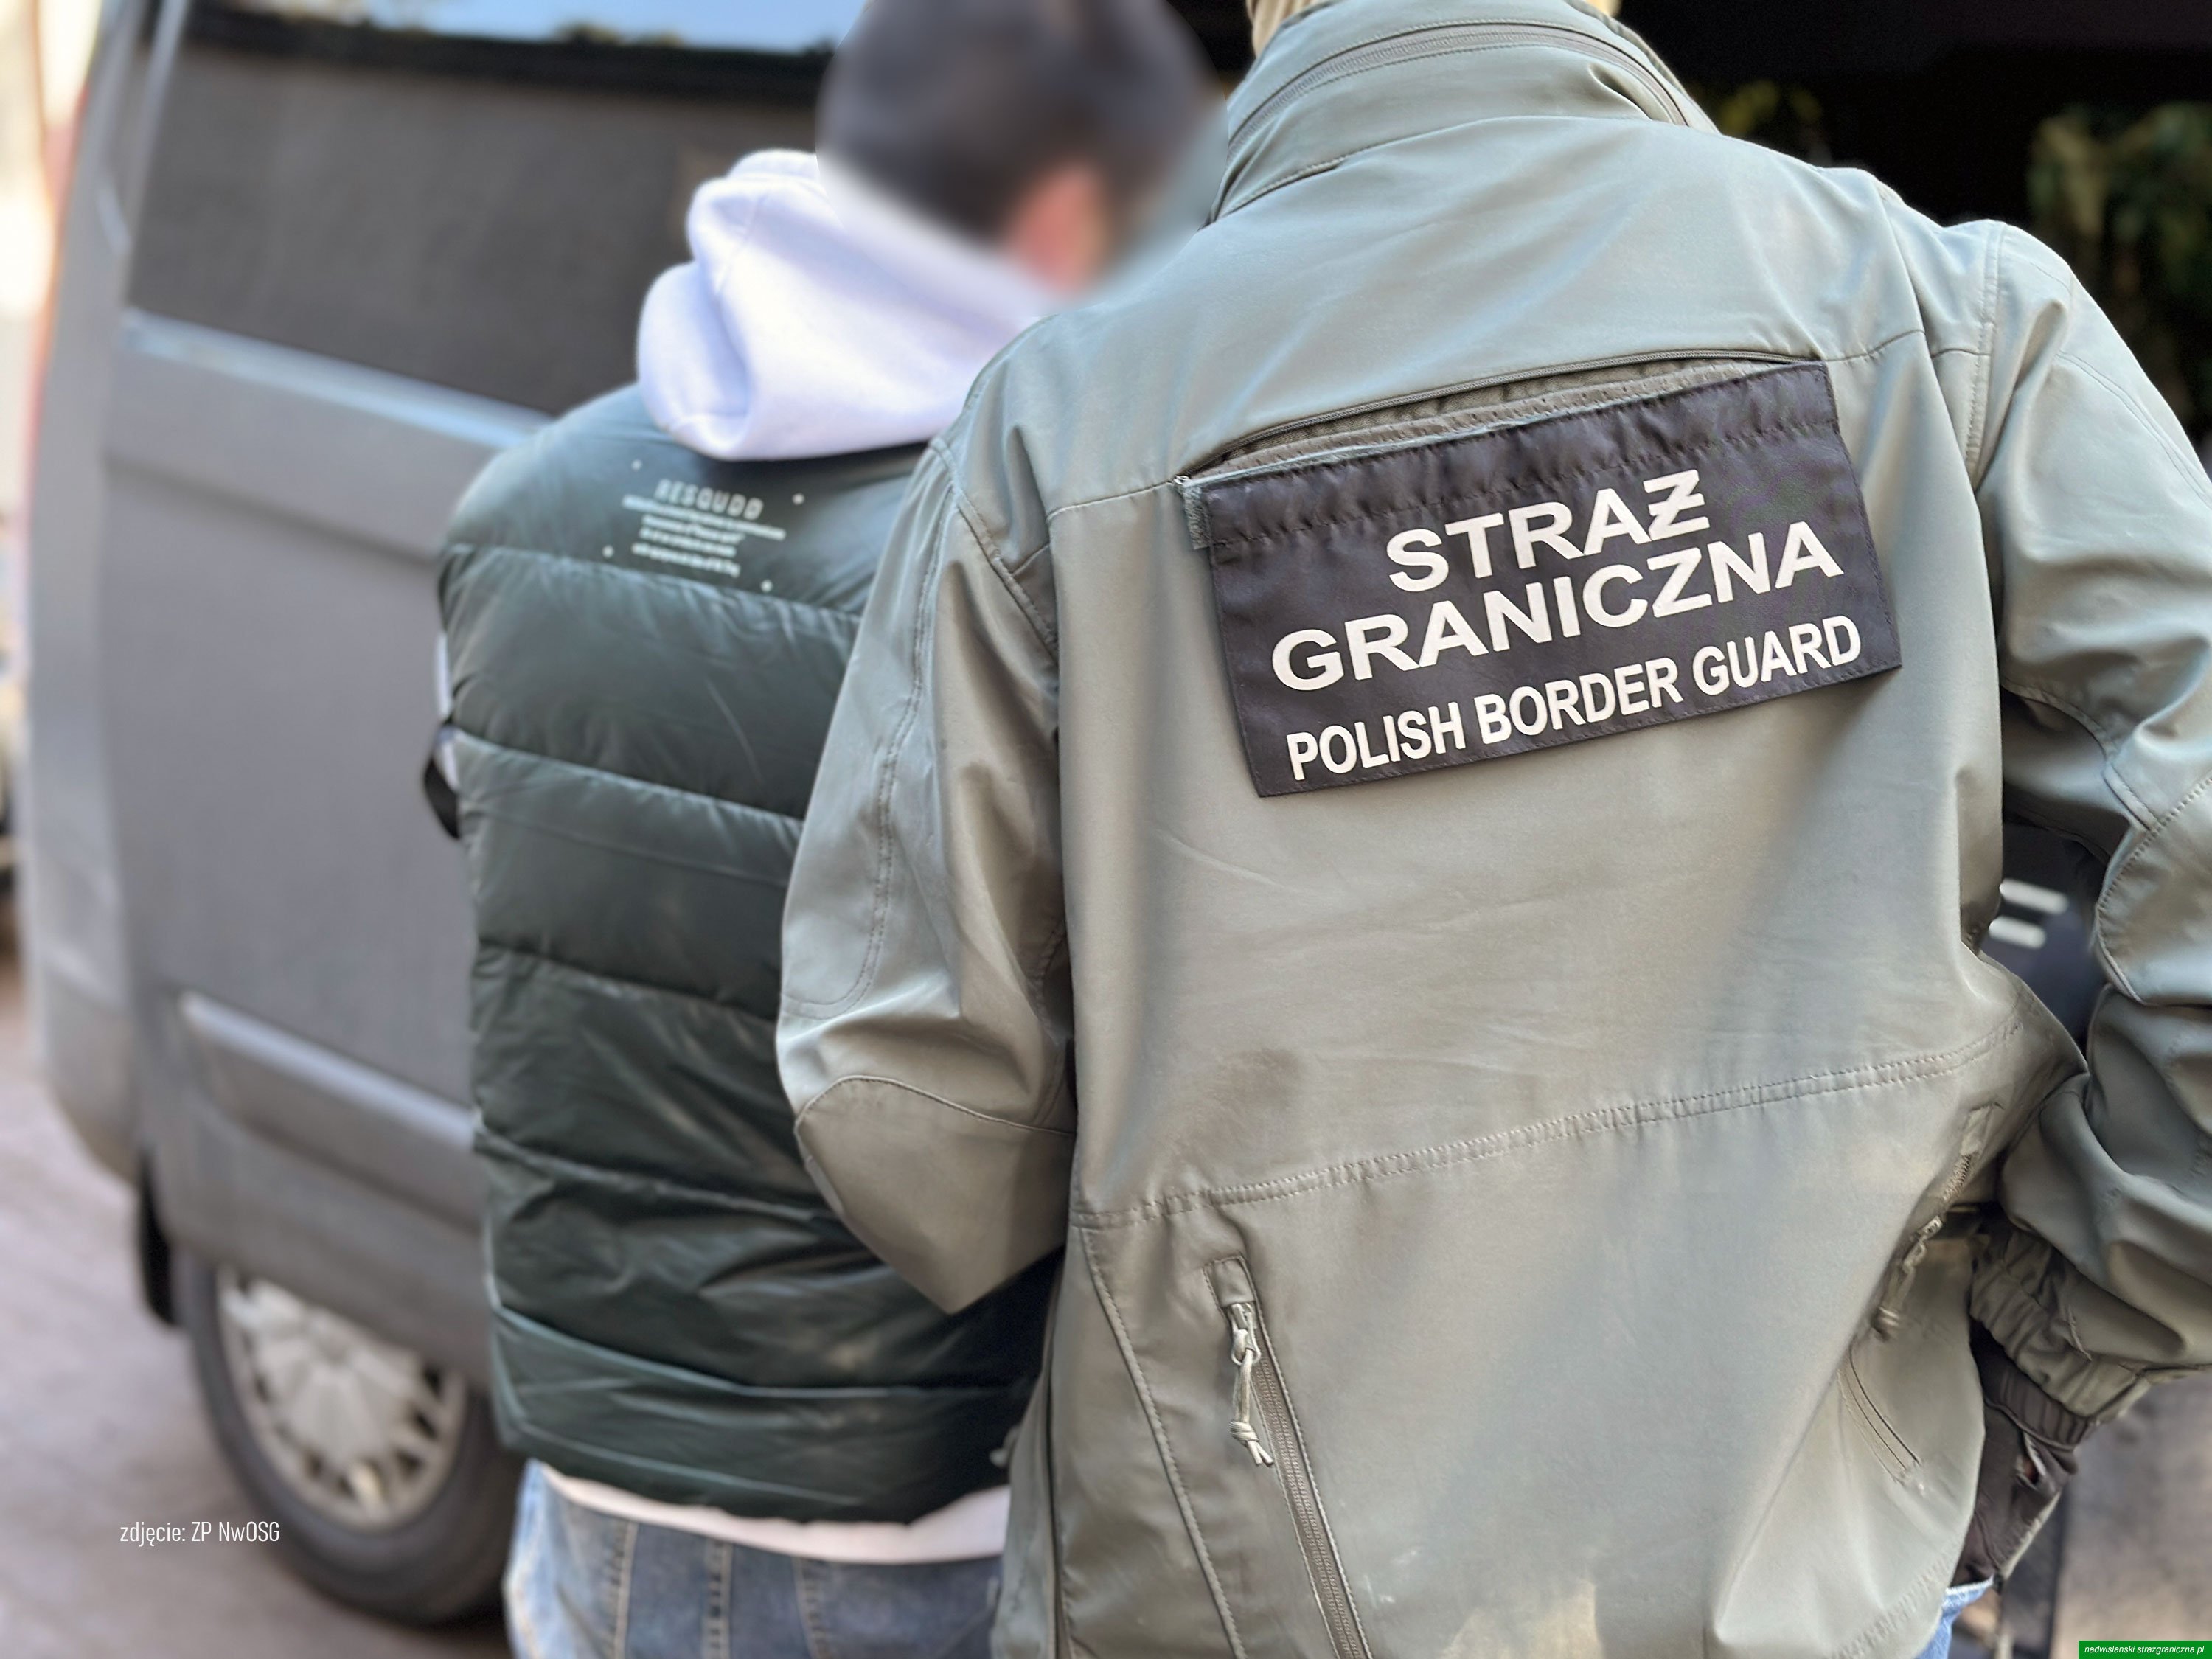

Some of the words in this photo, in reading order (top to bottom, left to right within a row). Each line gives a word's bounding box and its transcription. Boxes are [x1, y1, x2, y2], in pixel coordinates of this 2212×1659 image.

[1272, 521, 1845, 692] GRANICZNA
[1286, 703, 1466, 780] POLISH
[1478, 658, 1683, 745] BORDER
[1691, 615, 1863, 695] GUARD
